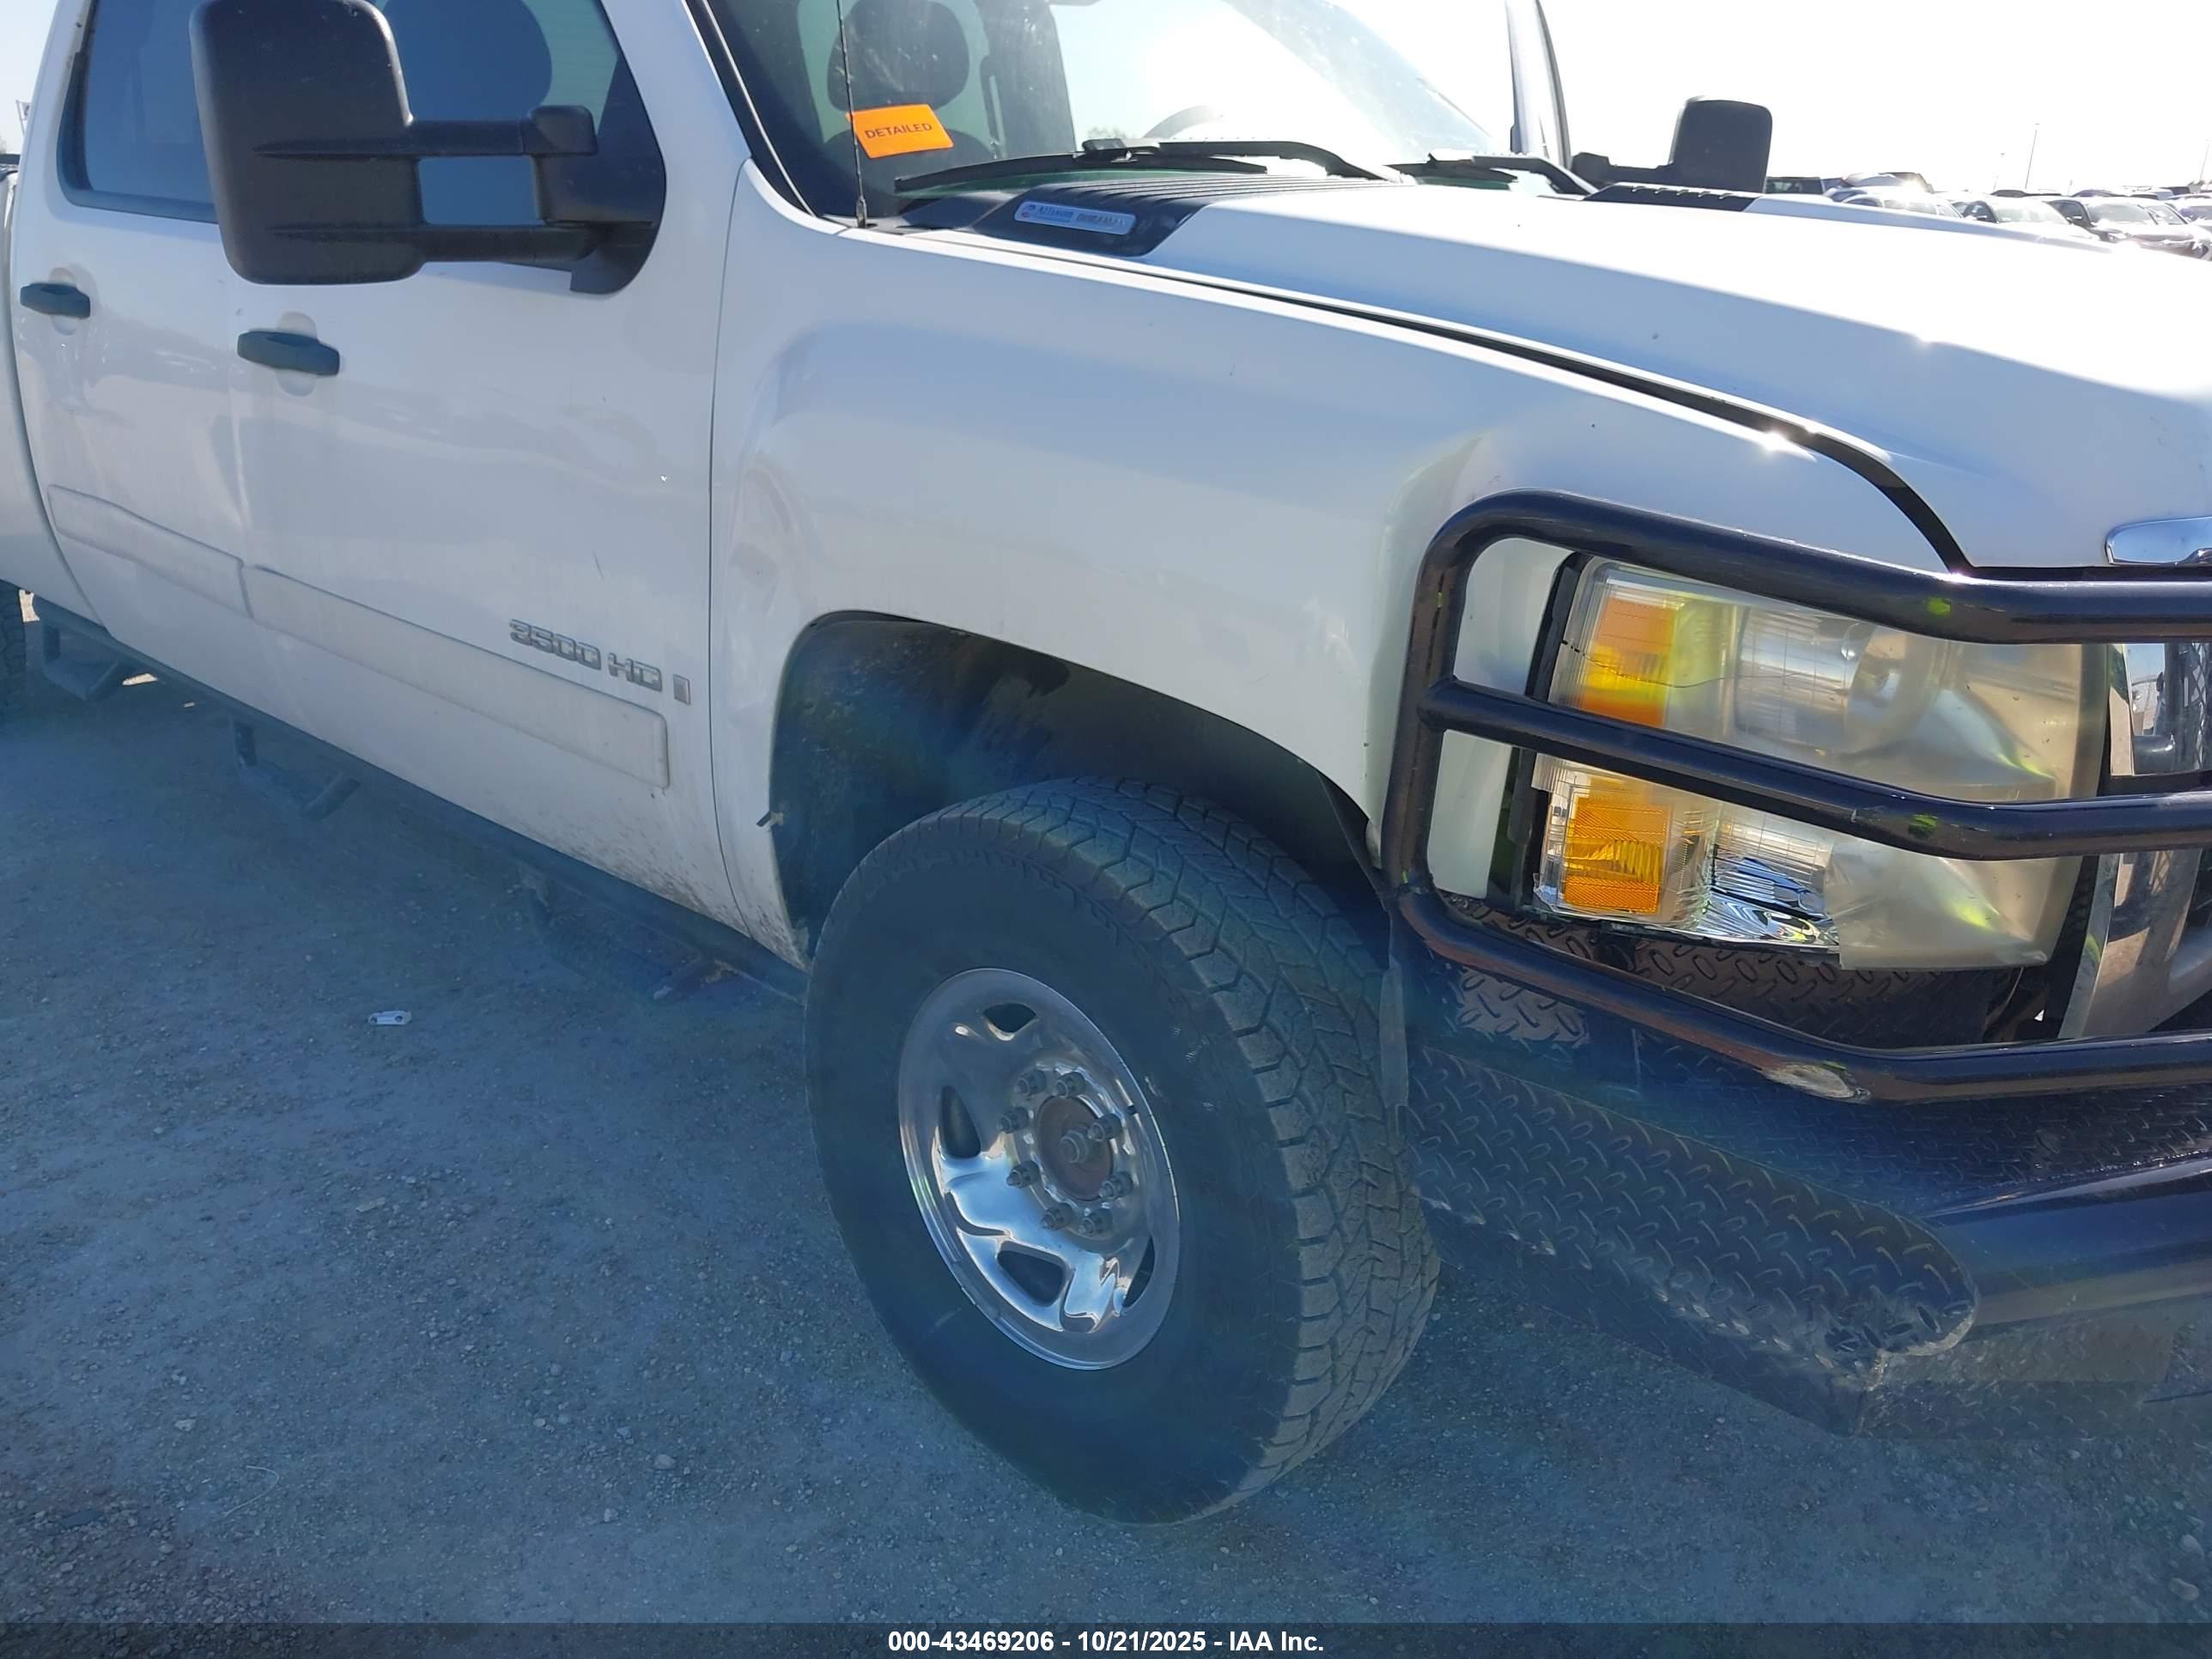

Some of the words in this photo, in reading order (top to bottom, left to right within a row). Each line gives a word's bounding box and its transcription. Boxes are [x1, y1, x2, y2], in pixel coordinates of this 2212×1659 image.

[865, 123, 933, 139] DETAILED
[508, 618, 602, 671] 3500
[607, 652, 663, 692] HD
